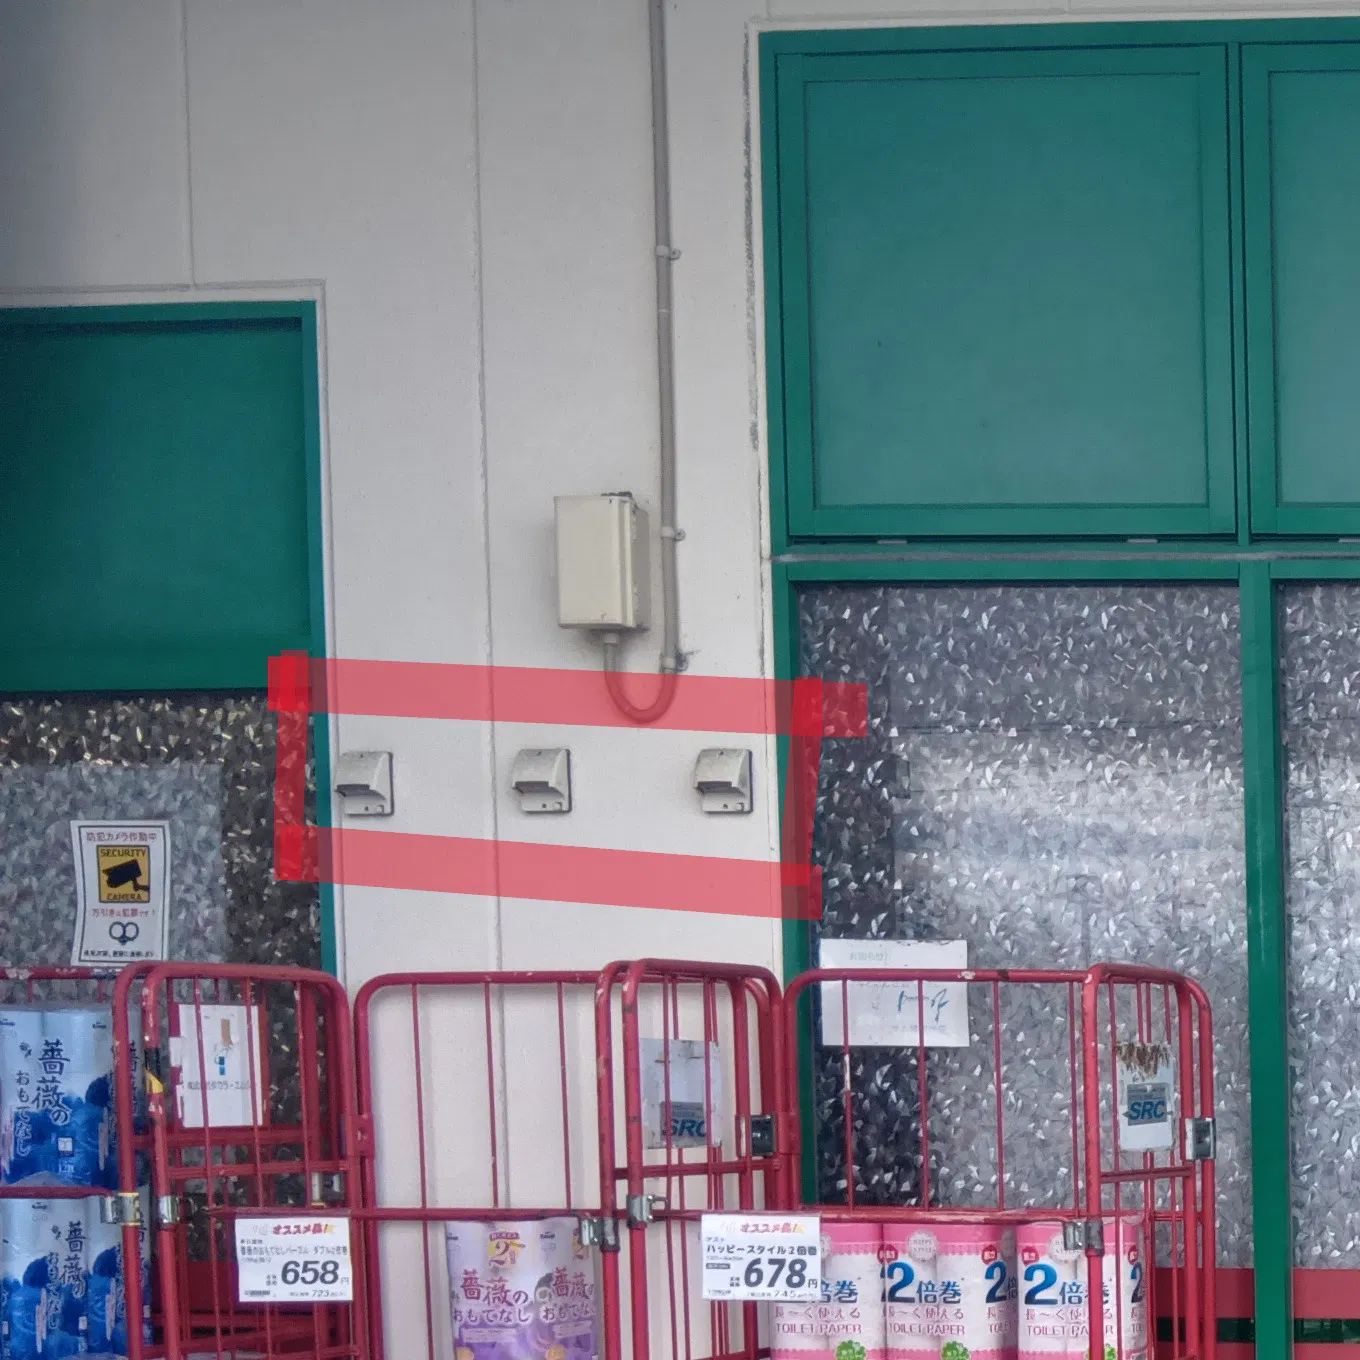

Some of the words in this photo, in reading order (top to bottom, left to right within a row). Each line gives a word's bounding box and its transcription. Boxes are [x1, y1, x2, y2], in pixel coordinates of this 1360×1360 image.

[100, 849, 147, 857] SECURITY
[31, 1038, 70, 1124] 薔薇の
[16, 1070, 31, 1156] おもてなし
[1130, 1100, 1166, 1120] SRC
[59, 1220, 86, 1298] 薔薇の
[281, 1260, 340, 1285] 658
[744, 1258, 807, 1288] 678
[808, 1278, 818, 1288] 円
[887, 1261, 961, 1304] 2倍巻
[460, 1268, 529, 1306] 薔薇の
[454, 1308, 530, 1323] おもてなし
[776, 1323, 814, 1333] TOILET
[820, 1324, 862, 1334] PAPER
[889, 1325, 924, 1334] TOILET
[927, 1325, 965, 1335] PAPER
[1027, 1326, 1067, 1335] TOILET
[1071, 1326, 1113, 1335] PAR
